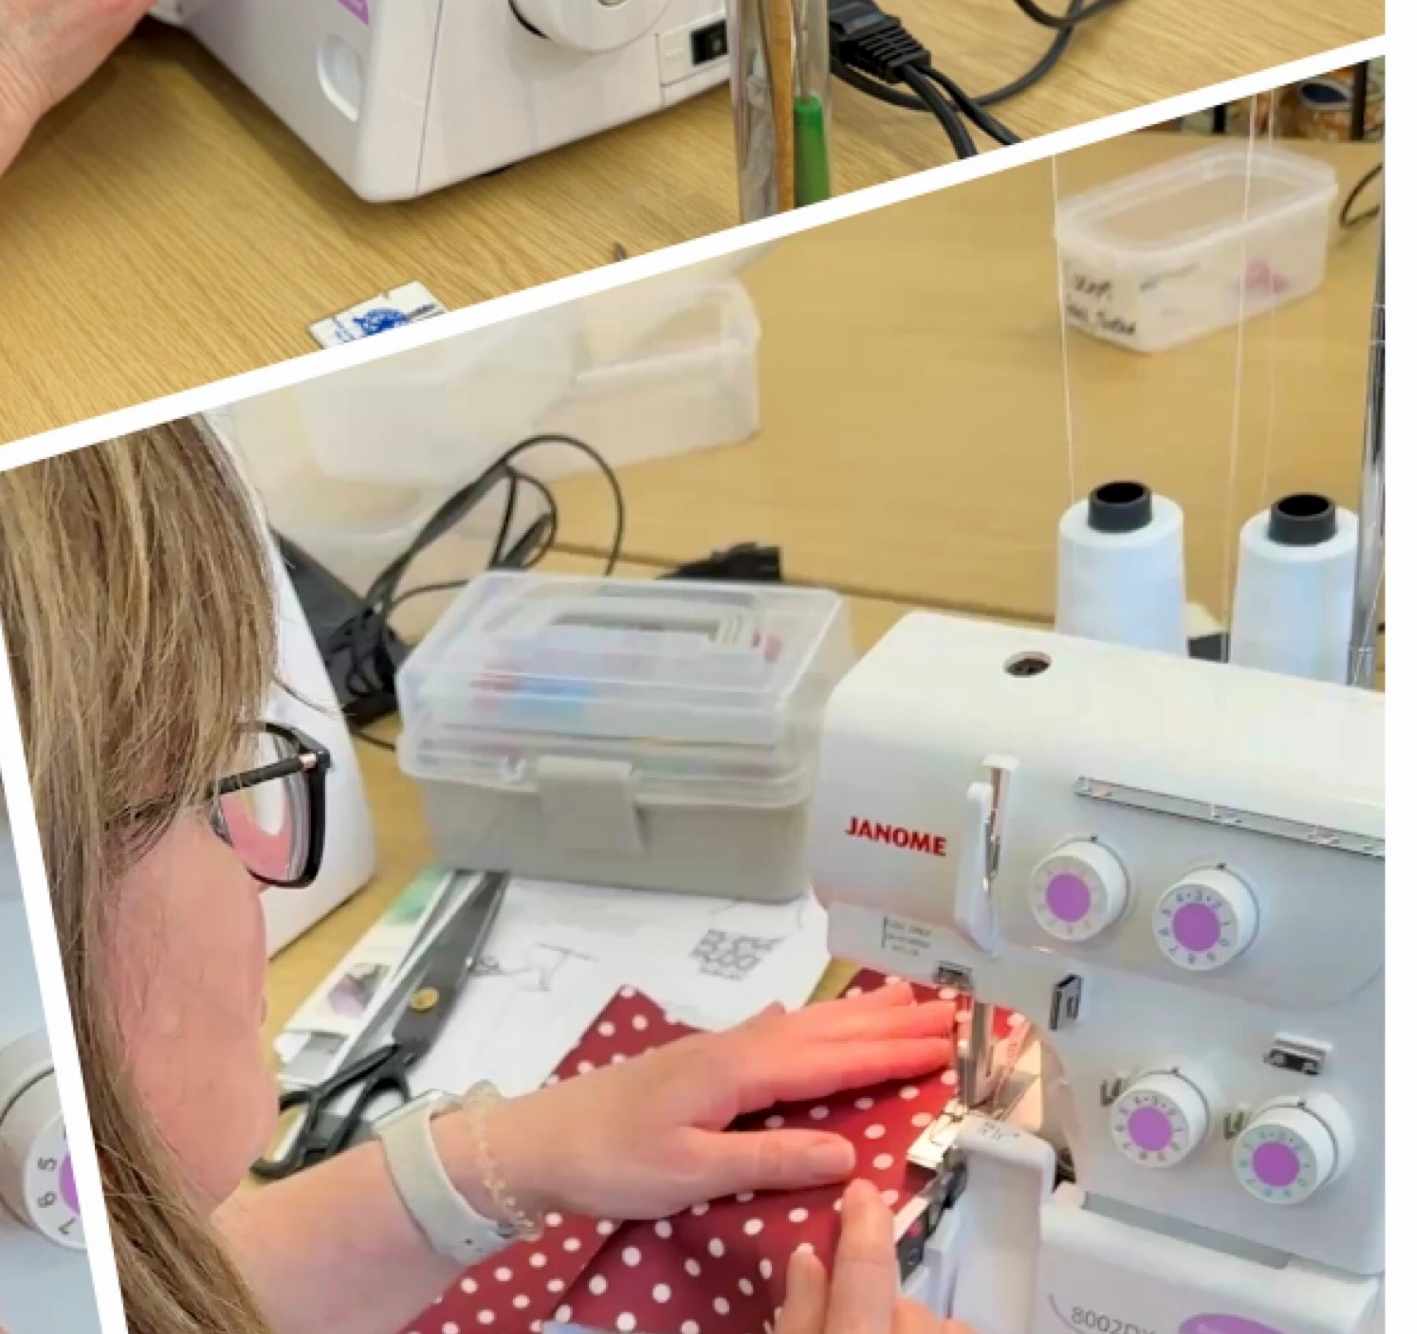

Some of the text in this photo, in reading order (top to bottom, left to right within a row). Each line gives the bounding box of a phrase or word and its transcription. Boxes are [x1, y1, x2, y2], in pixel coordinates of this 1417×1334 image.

[845, 815, 947, 857] JANOME
[37, 1157, 77, 1236] 5 6 7
